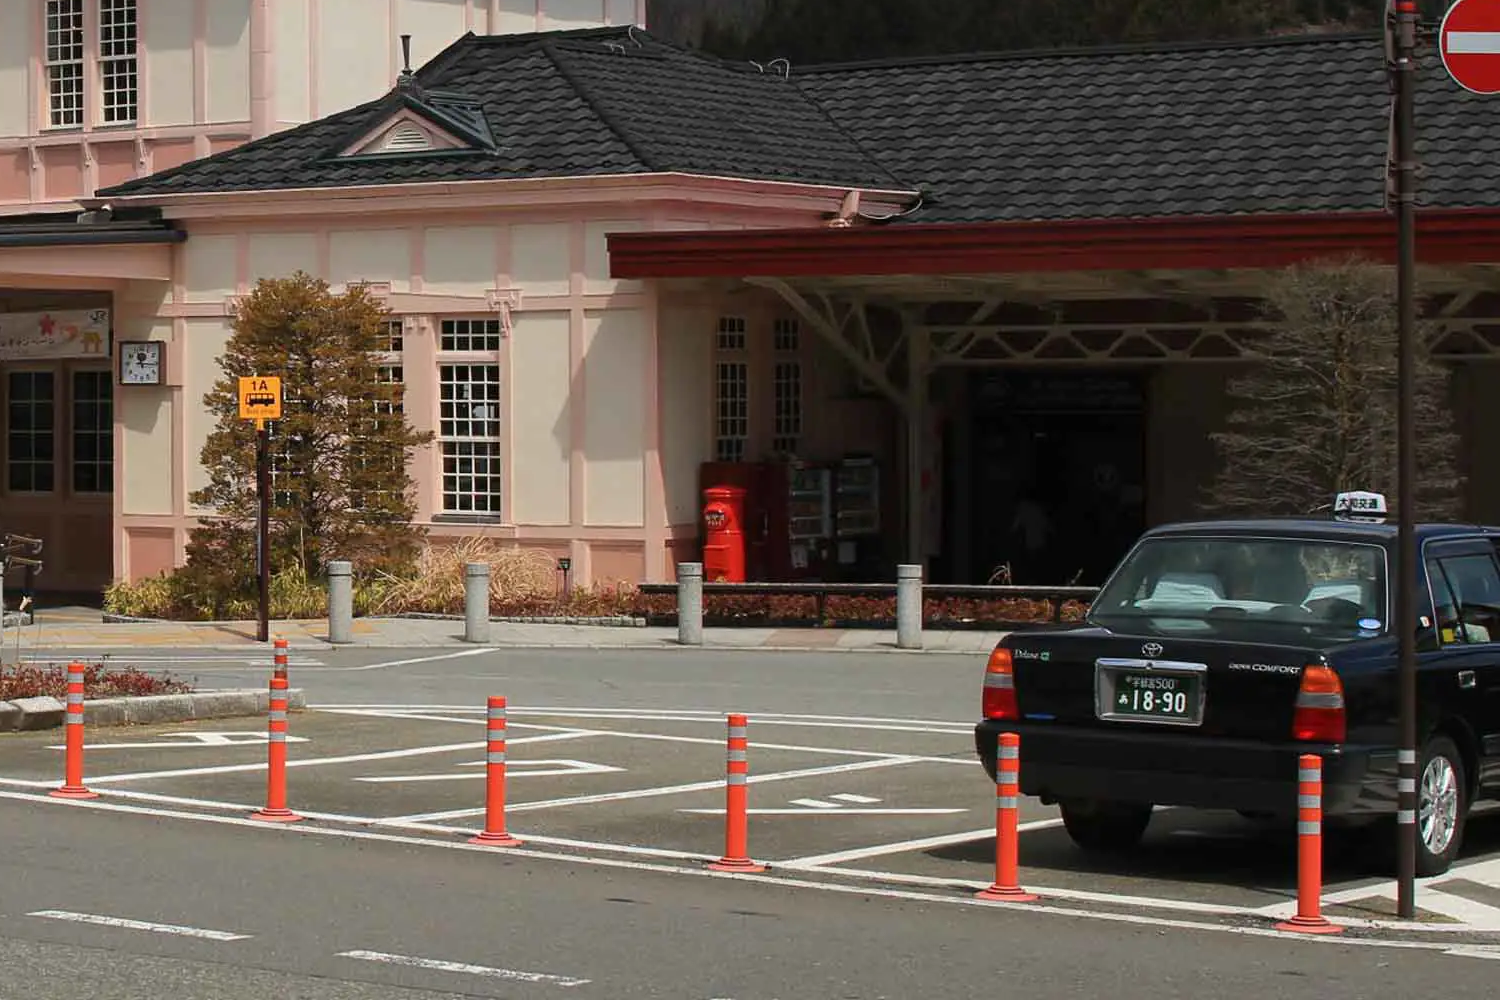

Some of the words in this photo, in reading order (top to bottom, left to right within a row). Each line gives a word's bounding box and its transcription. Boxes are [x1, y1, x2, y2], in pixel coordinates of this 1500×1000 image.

[251, 380, 268, 391] 1A
[1251, 663, 1301, 674] COMFORT
[1132, 689, 1187, 713] 18-90
